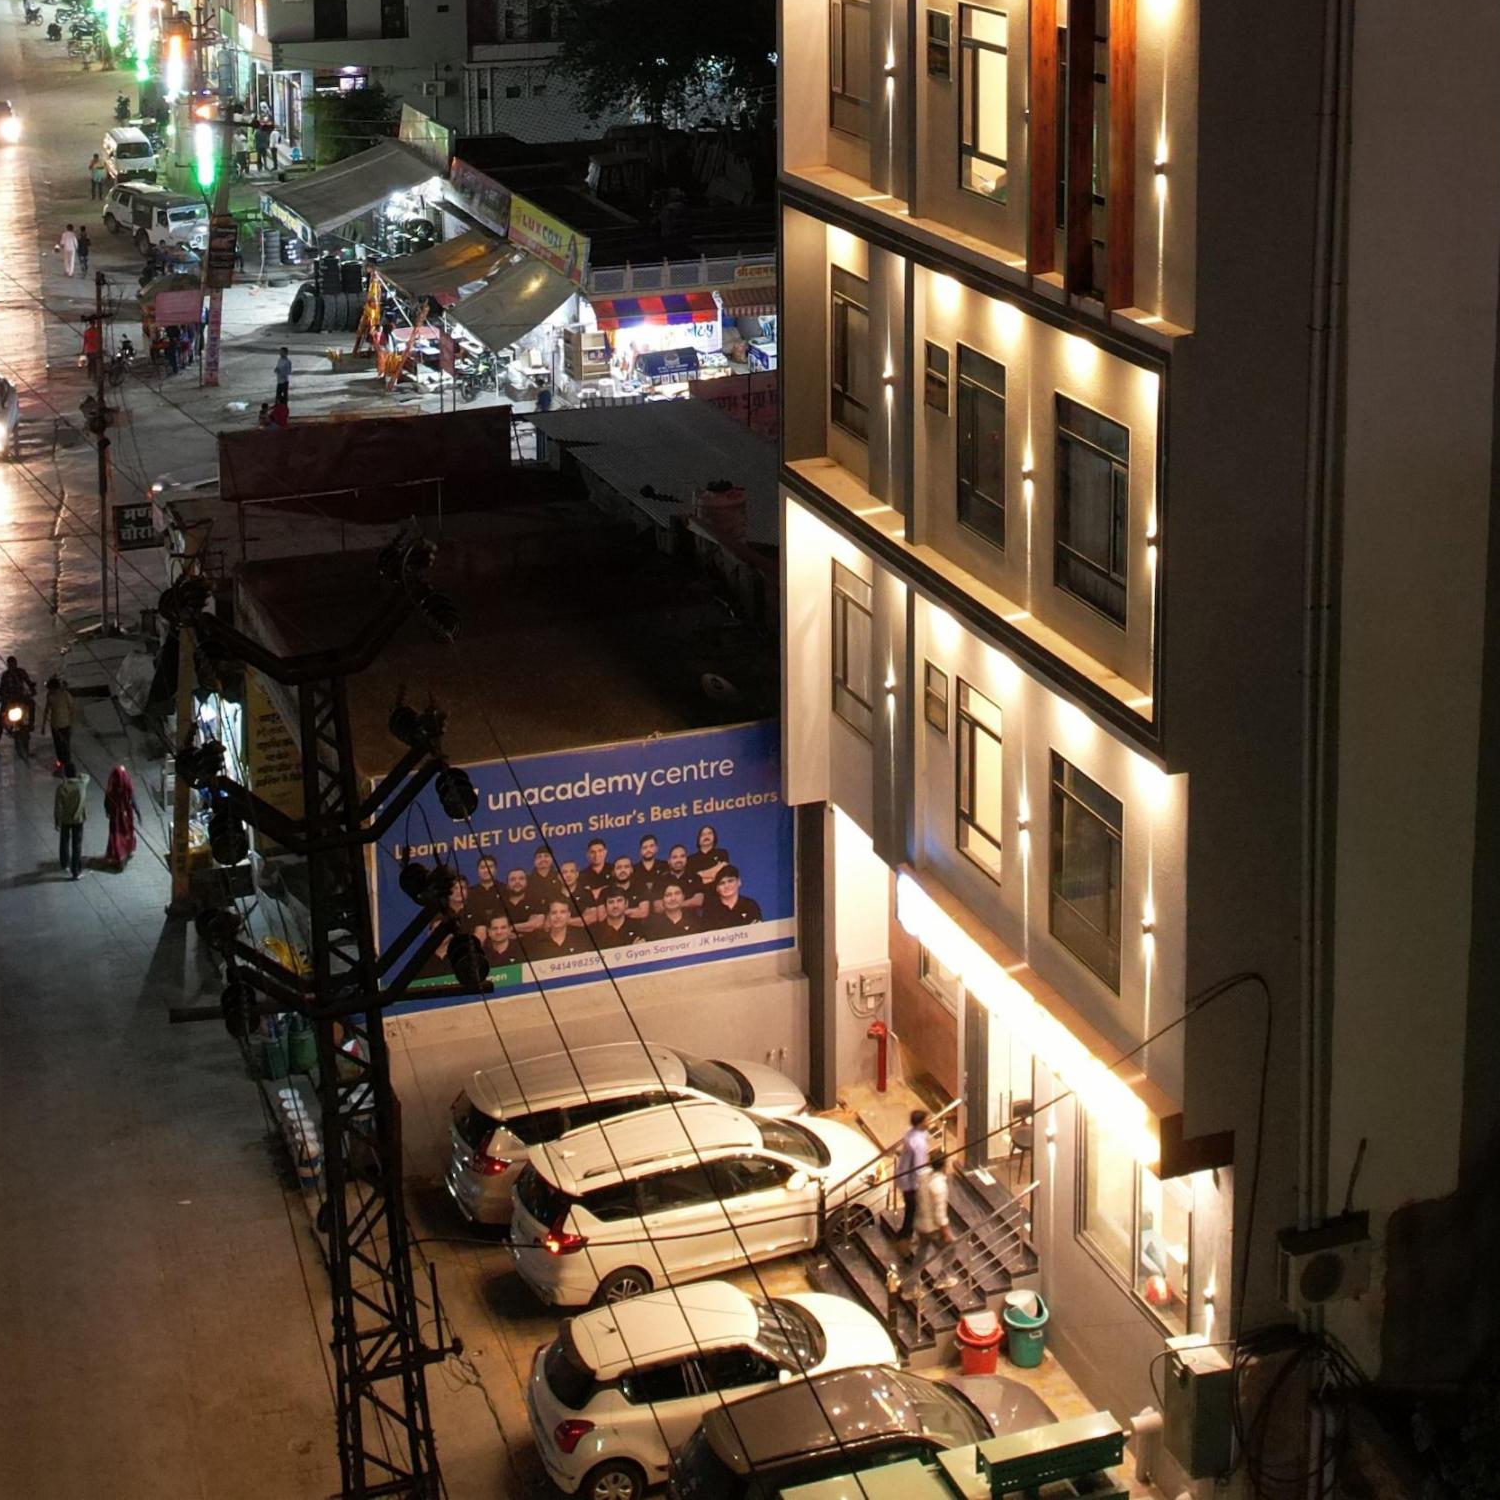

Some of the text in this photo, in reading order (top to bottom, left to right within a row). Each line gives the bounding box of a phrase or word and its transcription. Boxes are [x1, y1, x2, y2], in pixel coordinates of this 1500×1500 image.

[488, 758, 735, 811] unacademy centre
[395, 791, 778, 860] Learn NEET UG from Sikar's Best Educators
[626, 947, 651, 962] Gyan
[699, 936, 710, 947] JK
[713, 930, 749, 946] Heights
